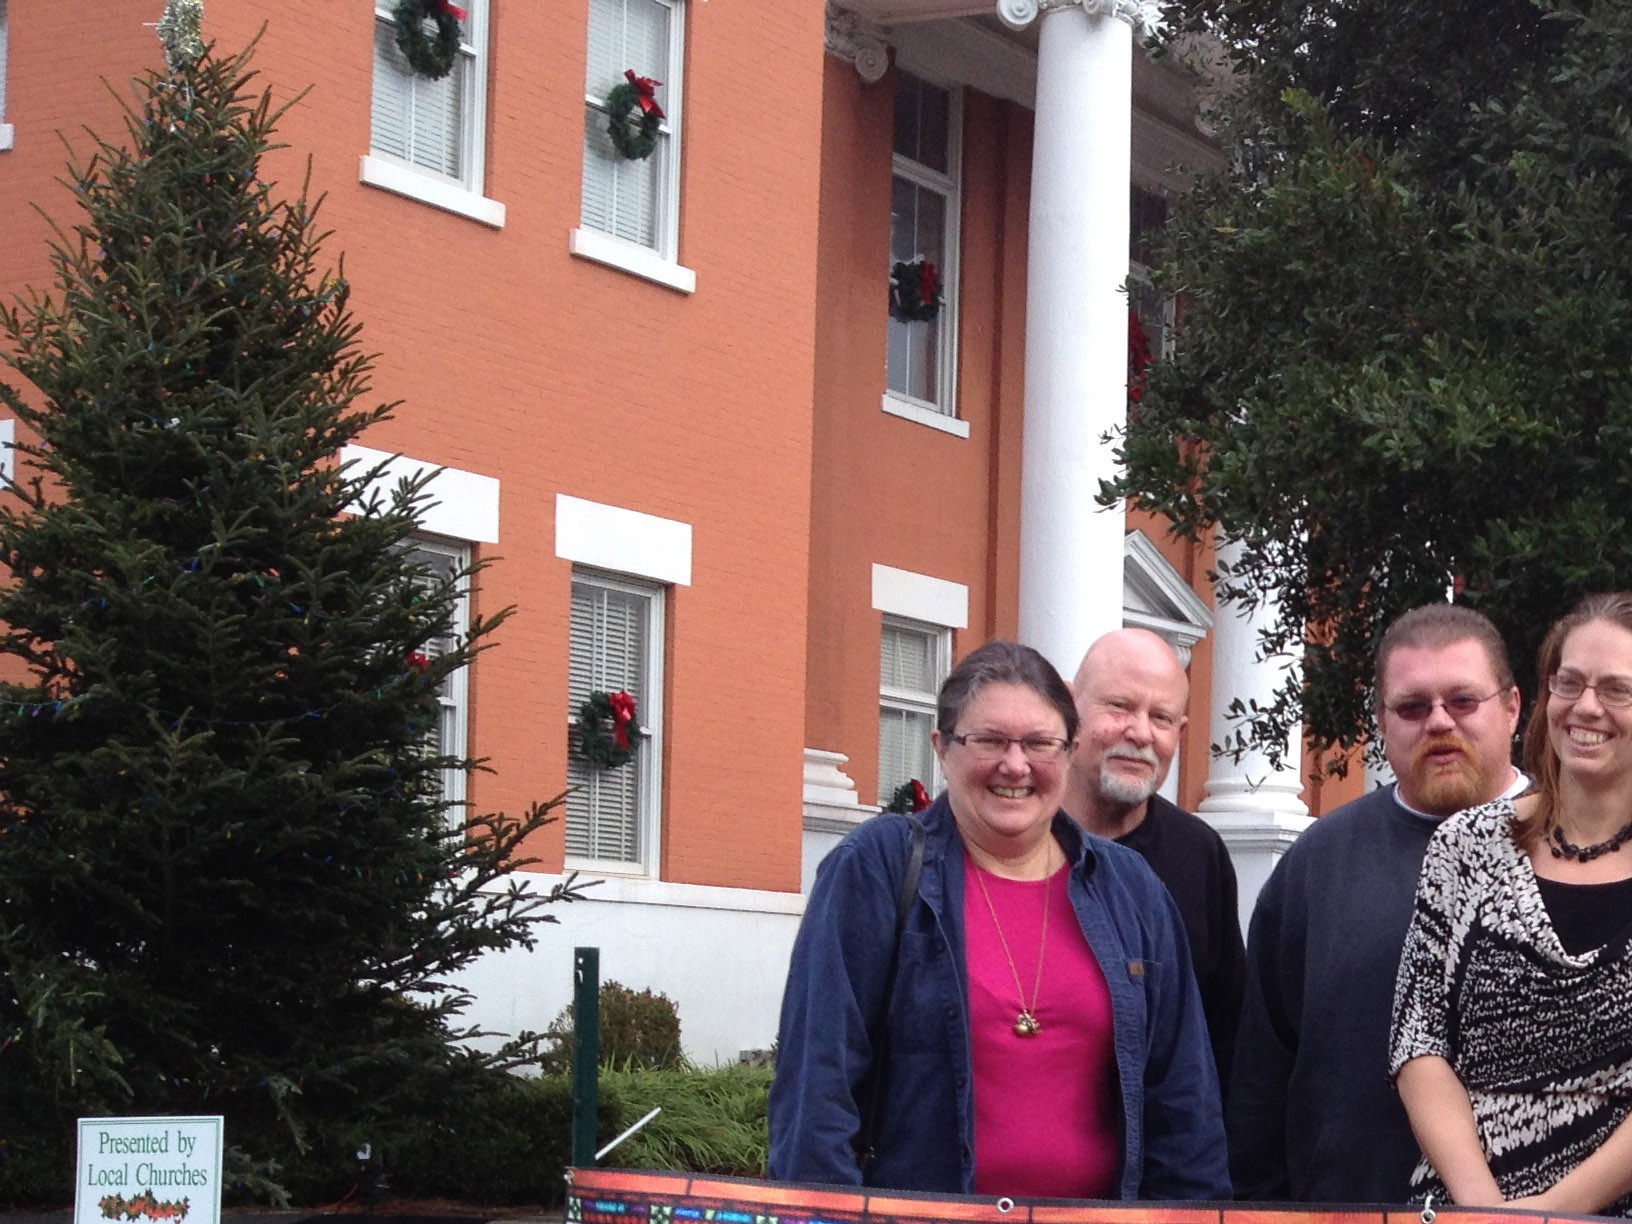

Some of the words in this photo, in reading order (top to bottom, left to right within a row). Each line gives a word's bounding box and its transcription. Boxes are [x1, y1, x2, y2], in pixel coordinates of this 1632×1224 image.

[98, 1130, 168, 1154] Presented
[178, 1130, 196, 1158] by
[88, 1163, 128, 1186] Local
[136, 1162, 207, 1186] Churches
